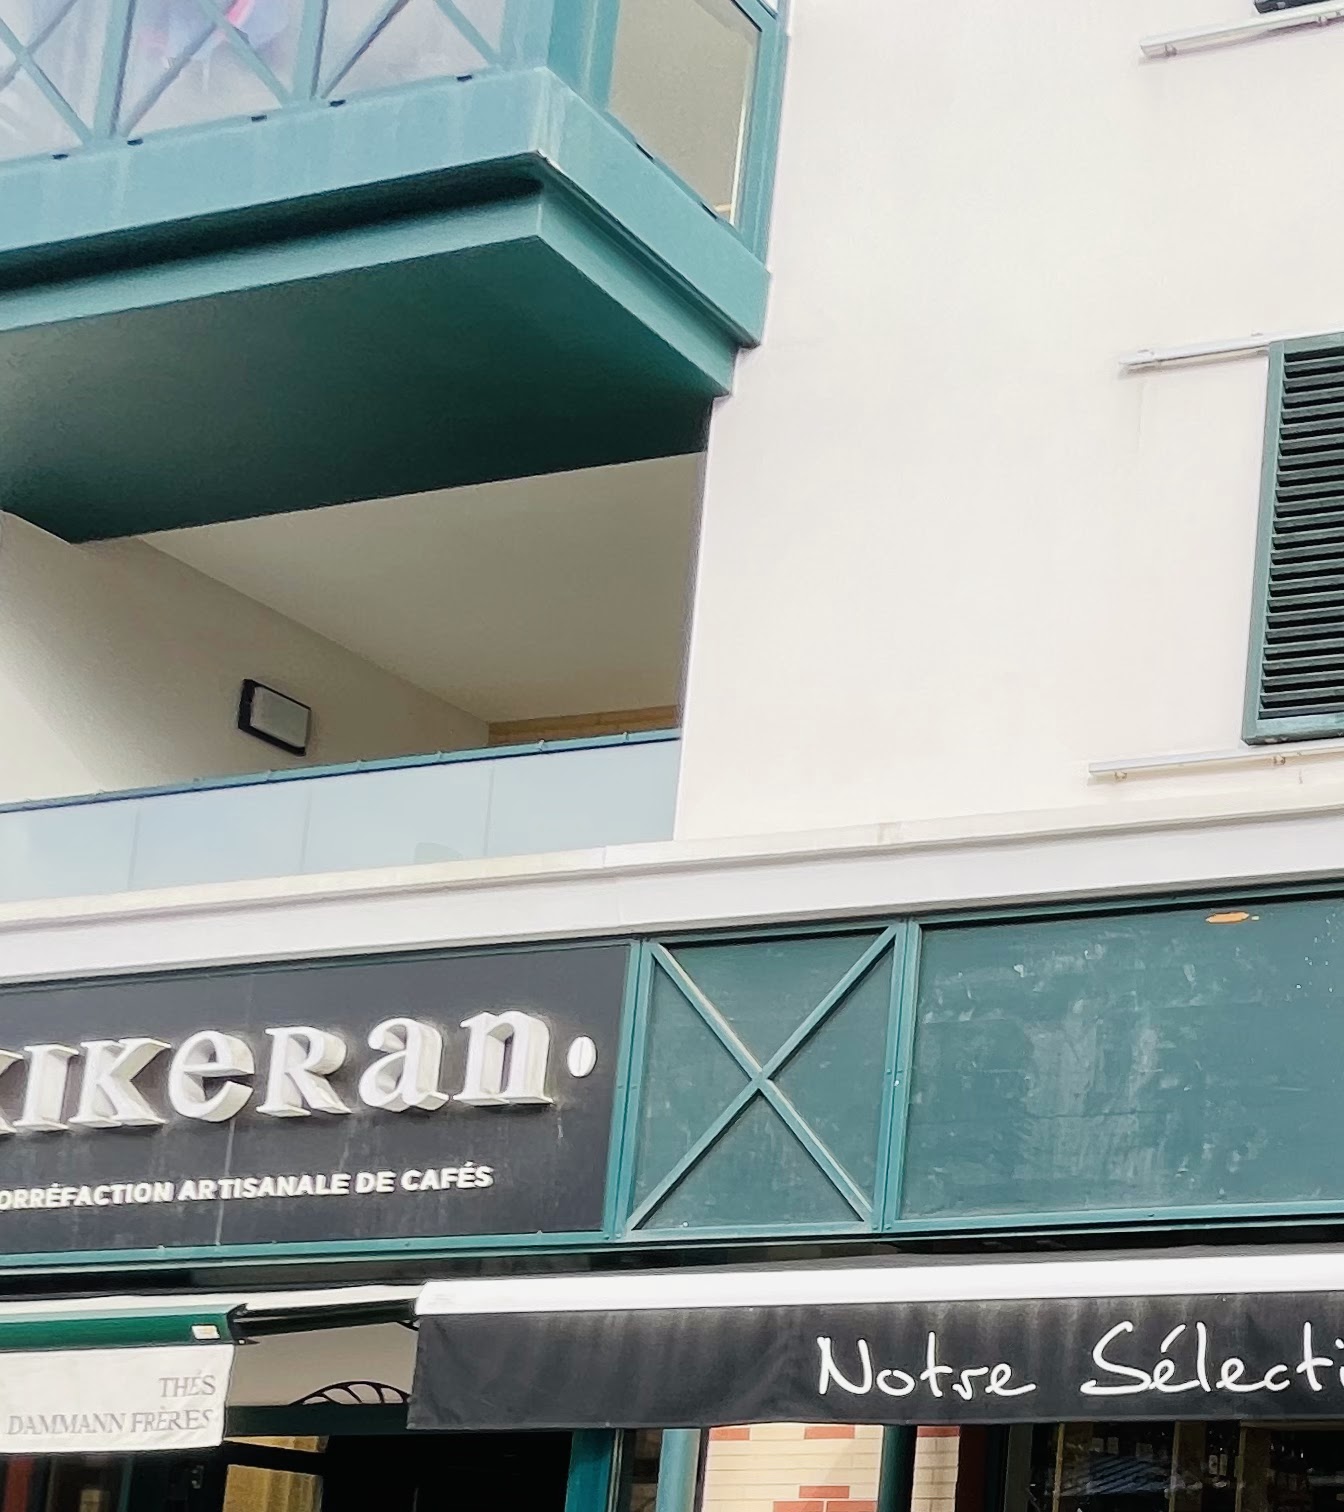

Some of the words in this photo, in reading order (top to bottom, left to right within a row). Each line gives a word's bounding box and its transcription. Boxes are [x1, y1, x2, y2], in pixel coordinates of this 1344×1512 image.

[178, 1172, 352, 1201] ARTISANALE
[355, 1170, 397, 1195] DE
[400, 1160, 496, 1192] CAFÉS
[814, 1330, 1037, 1399] Notre
